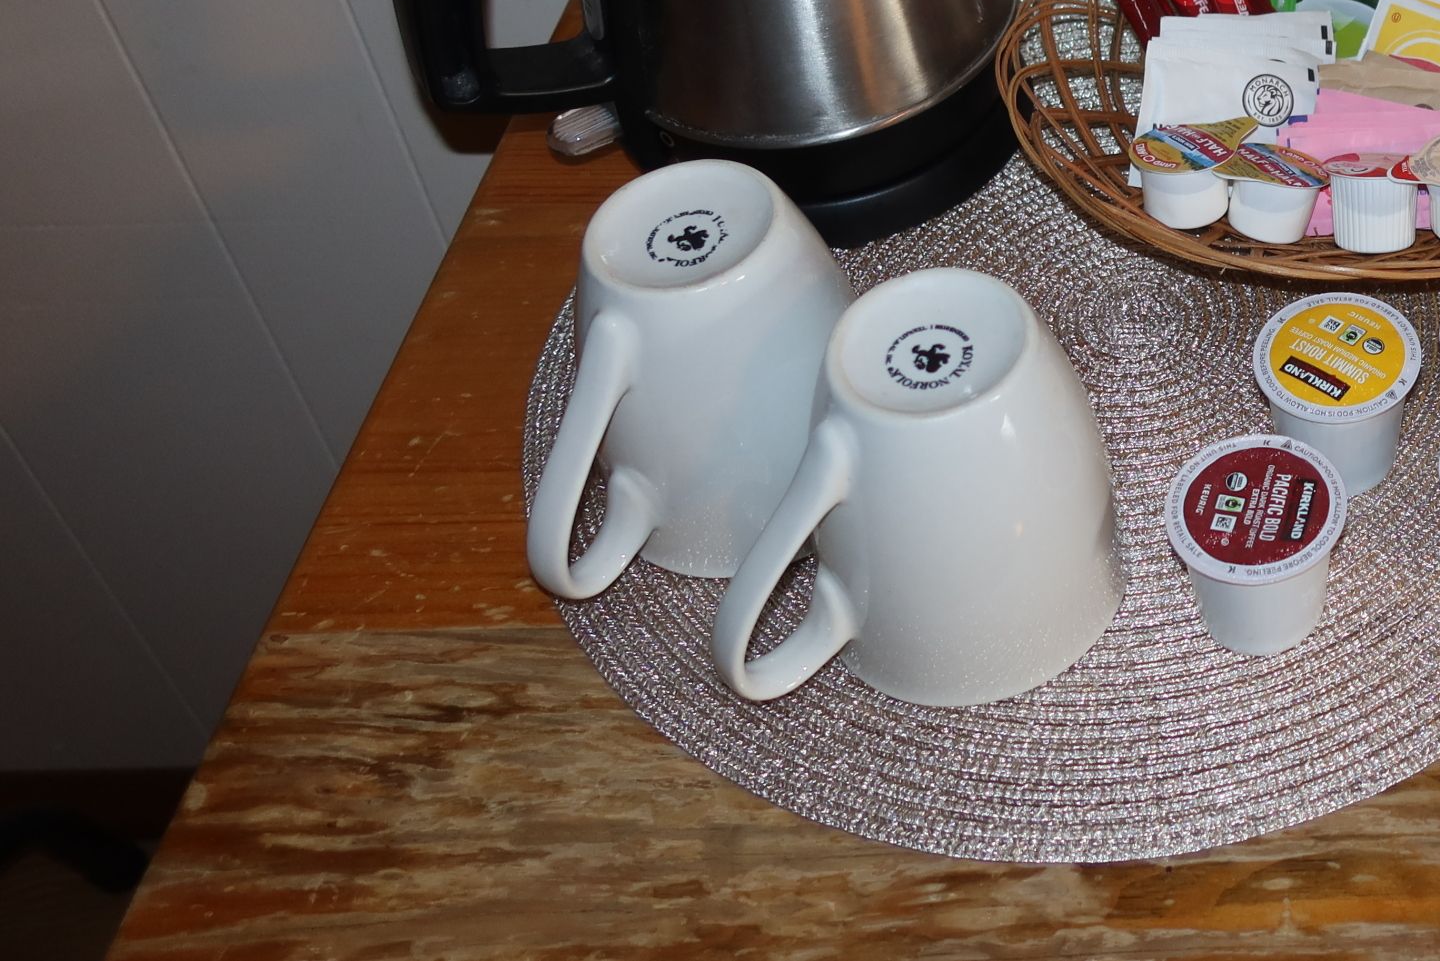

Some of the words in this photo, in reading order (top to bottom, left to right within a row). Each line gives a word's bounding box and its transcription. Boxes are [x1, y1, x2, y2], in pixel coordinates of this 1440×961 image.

[1250, 77, 1288, 97] MONARCH
[1197, 137, 1227, 156] HALF
[1237, 148, 1265, 167] HALF
[1290, 338, 1326, 360] ROAST
[1260, 352, 1268, 375] BEFORE
[1322, 354, 1369, 384] SUMMIT
[1265, 376, 1278, 391] COOL
[1284, 364, 1342, 397] KIRKLAND
[1277, 392, 1285, 400] TO
[1286, 398, 1309, 411] ALLOW
[1201, 450, 1217, 461] UNIT
[1188, 462, 1200, 473] NOT
[1172, 474, 1186, 503] LABELED
[1195, 483, 1212, 515] KEURIG
[1249, 489, 1260, 508] EXTRA
[1267, 474, 1292, 515] PACIFIC
[1291, 482, 1314, 539] KIRKLAND
[1332, 500, 1340, 525] ALLOW
[1173, 521, 1187, 544] RETAIL
[1260, 518, 1281, 541] BOLD
[1327, 527, 1336, 535] TO
[1314, 536, 1329, 552] COOL
